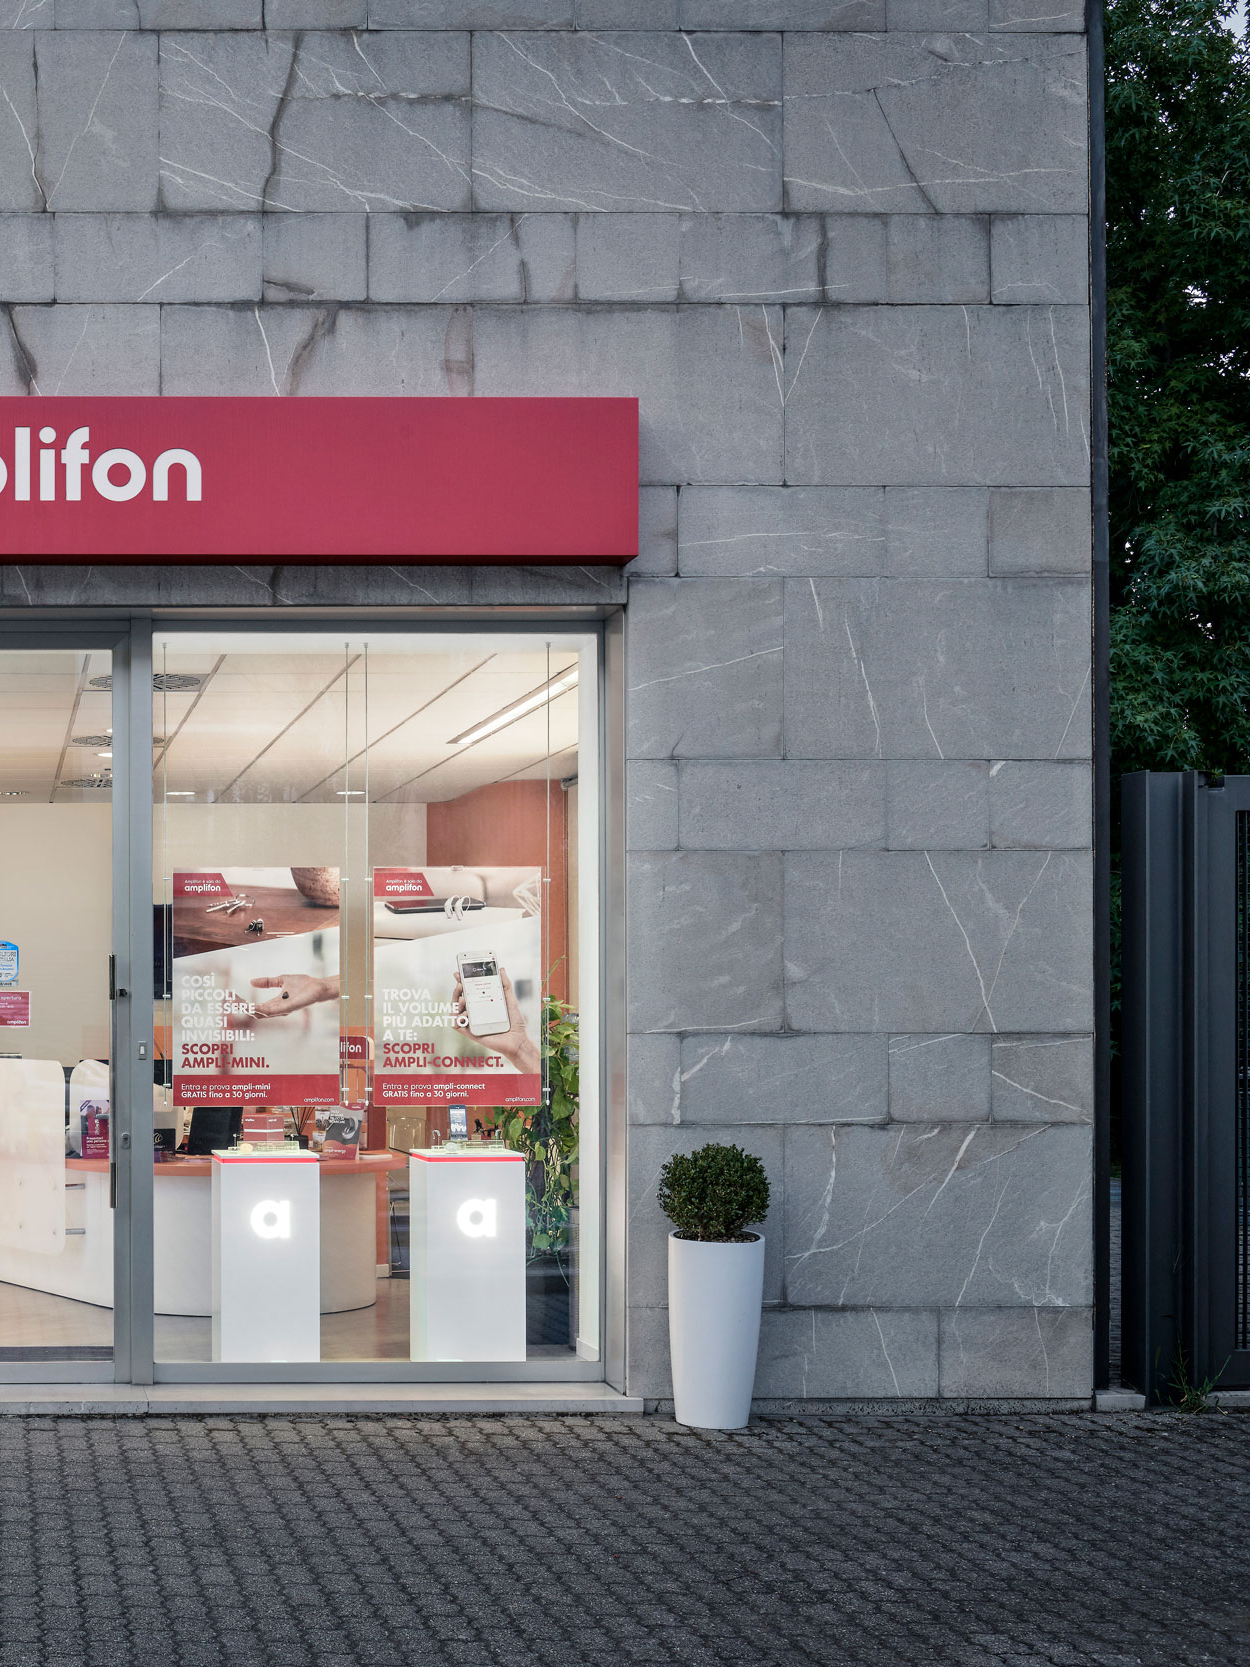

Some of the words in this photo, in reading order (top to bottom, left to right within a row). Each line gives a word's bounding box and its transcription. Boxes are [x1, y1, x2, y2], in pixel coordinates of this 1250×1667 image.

[184, 883, 221, 893] amplifon
[385, 883, 422, 893] amplifon
[181, 973, 215, 987] COSÌ
[181, 989, 236, 1001] PICCOLI
[382, 988, 431, 1001] TROVA
[181, 1002, 203, 1014] DA
[207, 1002, 256, 1014] ESSERE
[382, 1002, 396, 1014] IL
[399, 1002, 460, 1014] VOLUME
[181, 1016, 228, 1028] QUASI
[382, 1012, 406, 1028] PIÙ
[412, 1015, 469, 1028] ADATTO
[181, 1029, 255, 1042] INVISIBILI:
[382, 1029, 394, 1041] A
[399, 1029, 417, 1041] TE:
[181, 1043, 234, 1055] SCOPRI
[382, 1042, 435, 1055] SCOPRI
[181, 1056, 270, 1068] AMPLI-MINI.
[382, 1056, 504, 1068] AMPLI-CONNECT.
[231, 1083, 271, 1092] ampli-mini
[410, 1084, 432, 1092] prova
[433, 1082, 486, 1092] ampli-connect
[244, 1091, 268, 1100] giorni.
[382, 1090, 409, 1098] GRATIS
[410, 1090, 425, 1098] fino
[433, 1090, 444, 1098] 30
[445, 1090, 469, 1099] giorni.
[250, 1199, 291, 1239] a
[456, 1198, 497, 1238] a
